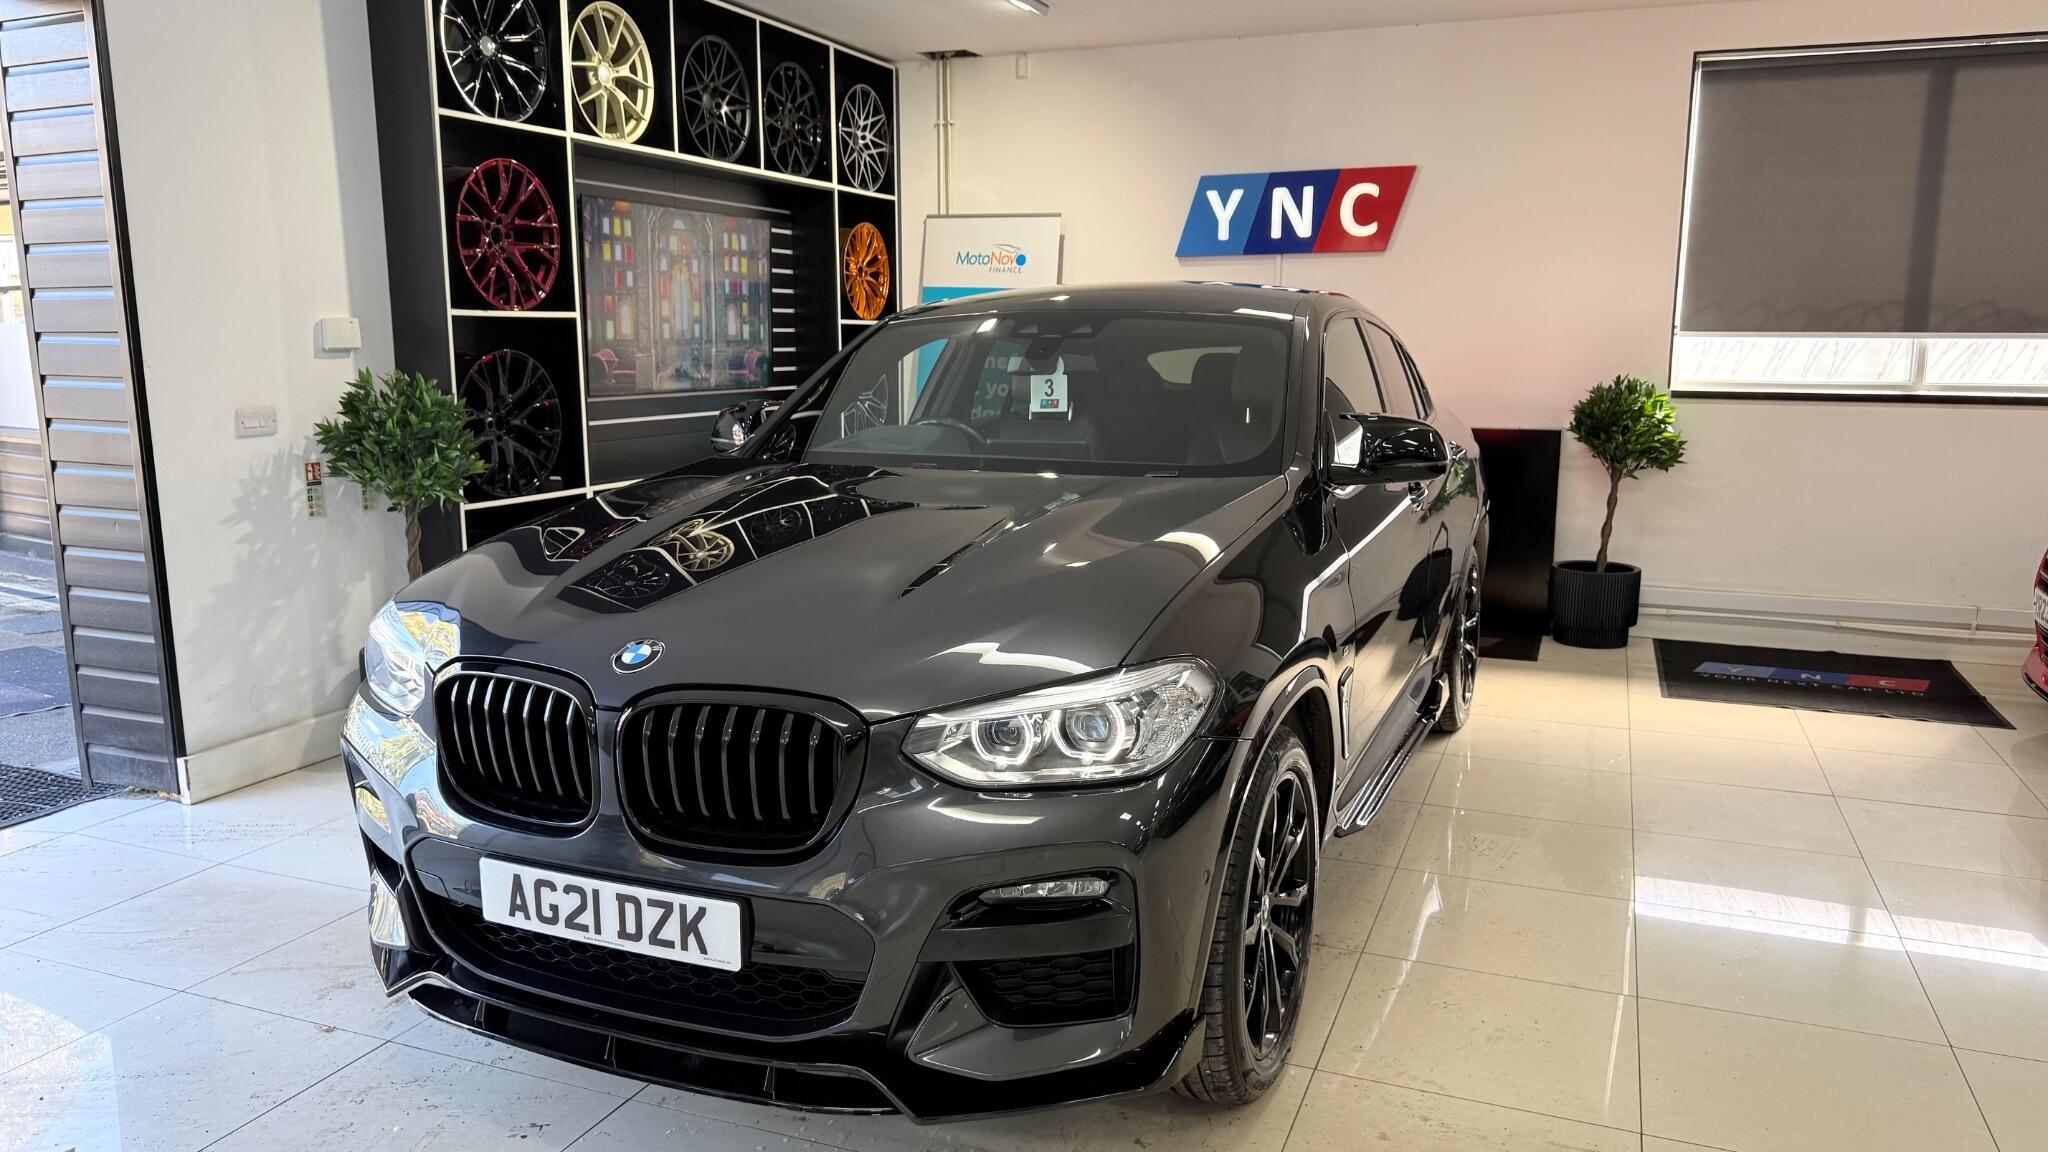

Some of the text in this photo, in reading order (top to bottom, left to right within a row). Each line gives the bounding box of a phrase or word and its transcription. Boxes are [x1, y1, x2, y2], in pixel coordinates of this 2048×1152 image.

[1206, 182, 1380, 240] YNC
[955, 250, 1027, 266] MotoNovo
[989, 266, 1022, 274] FINANCE
[1044, 378, 1055, 397] 3
[1701, 673, 1756, 682] YOUR
[508, 873, 708, 955] AG21 DZK
